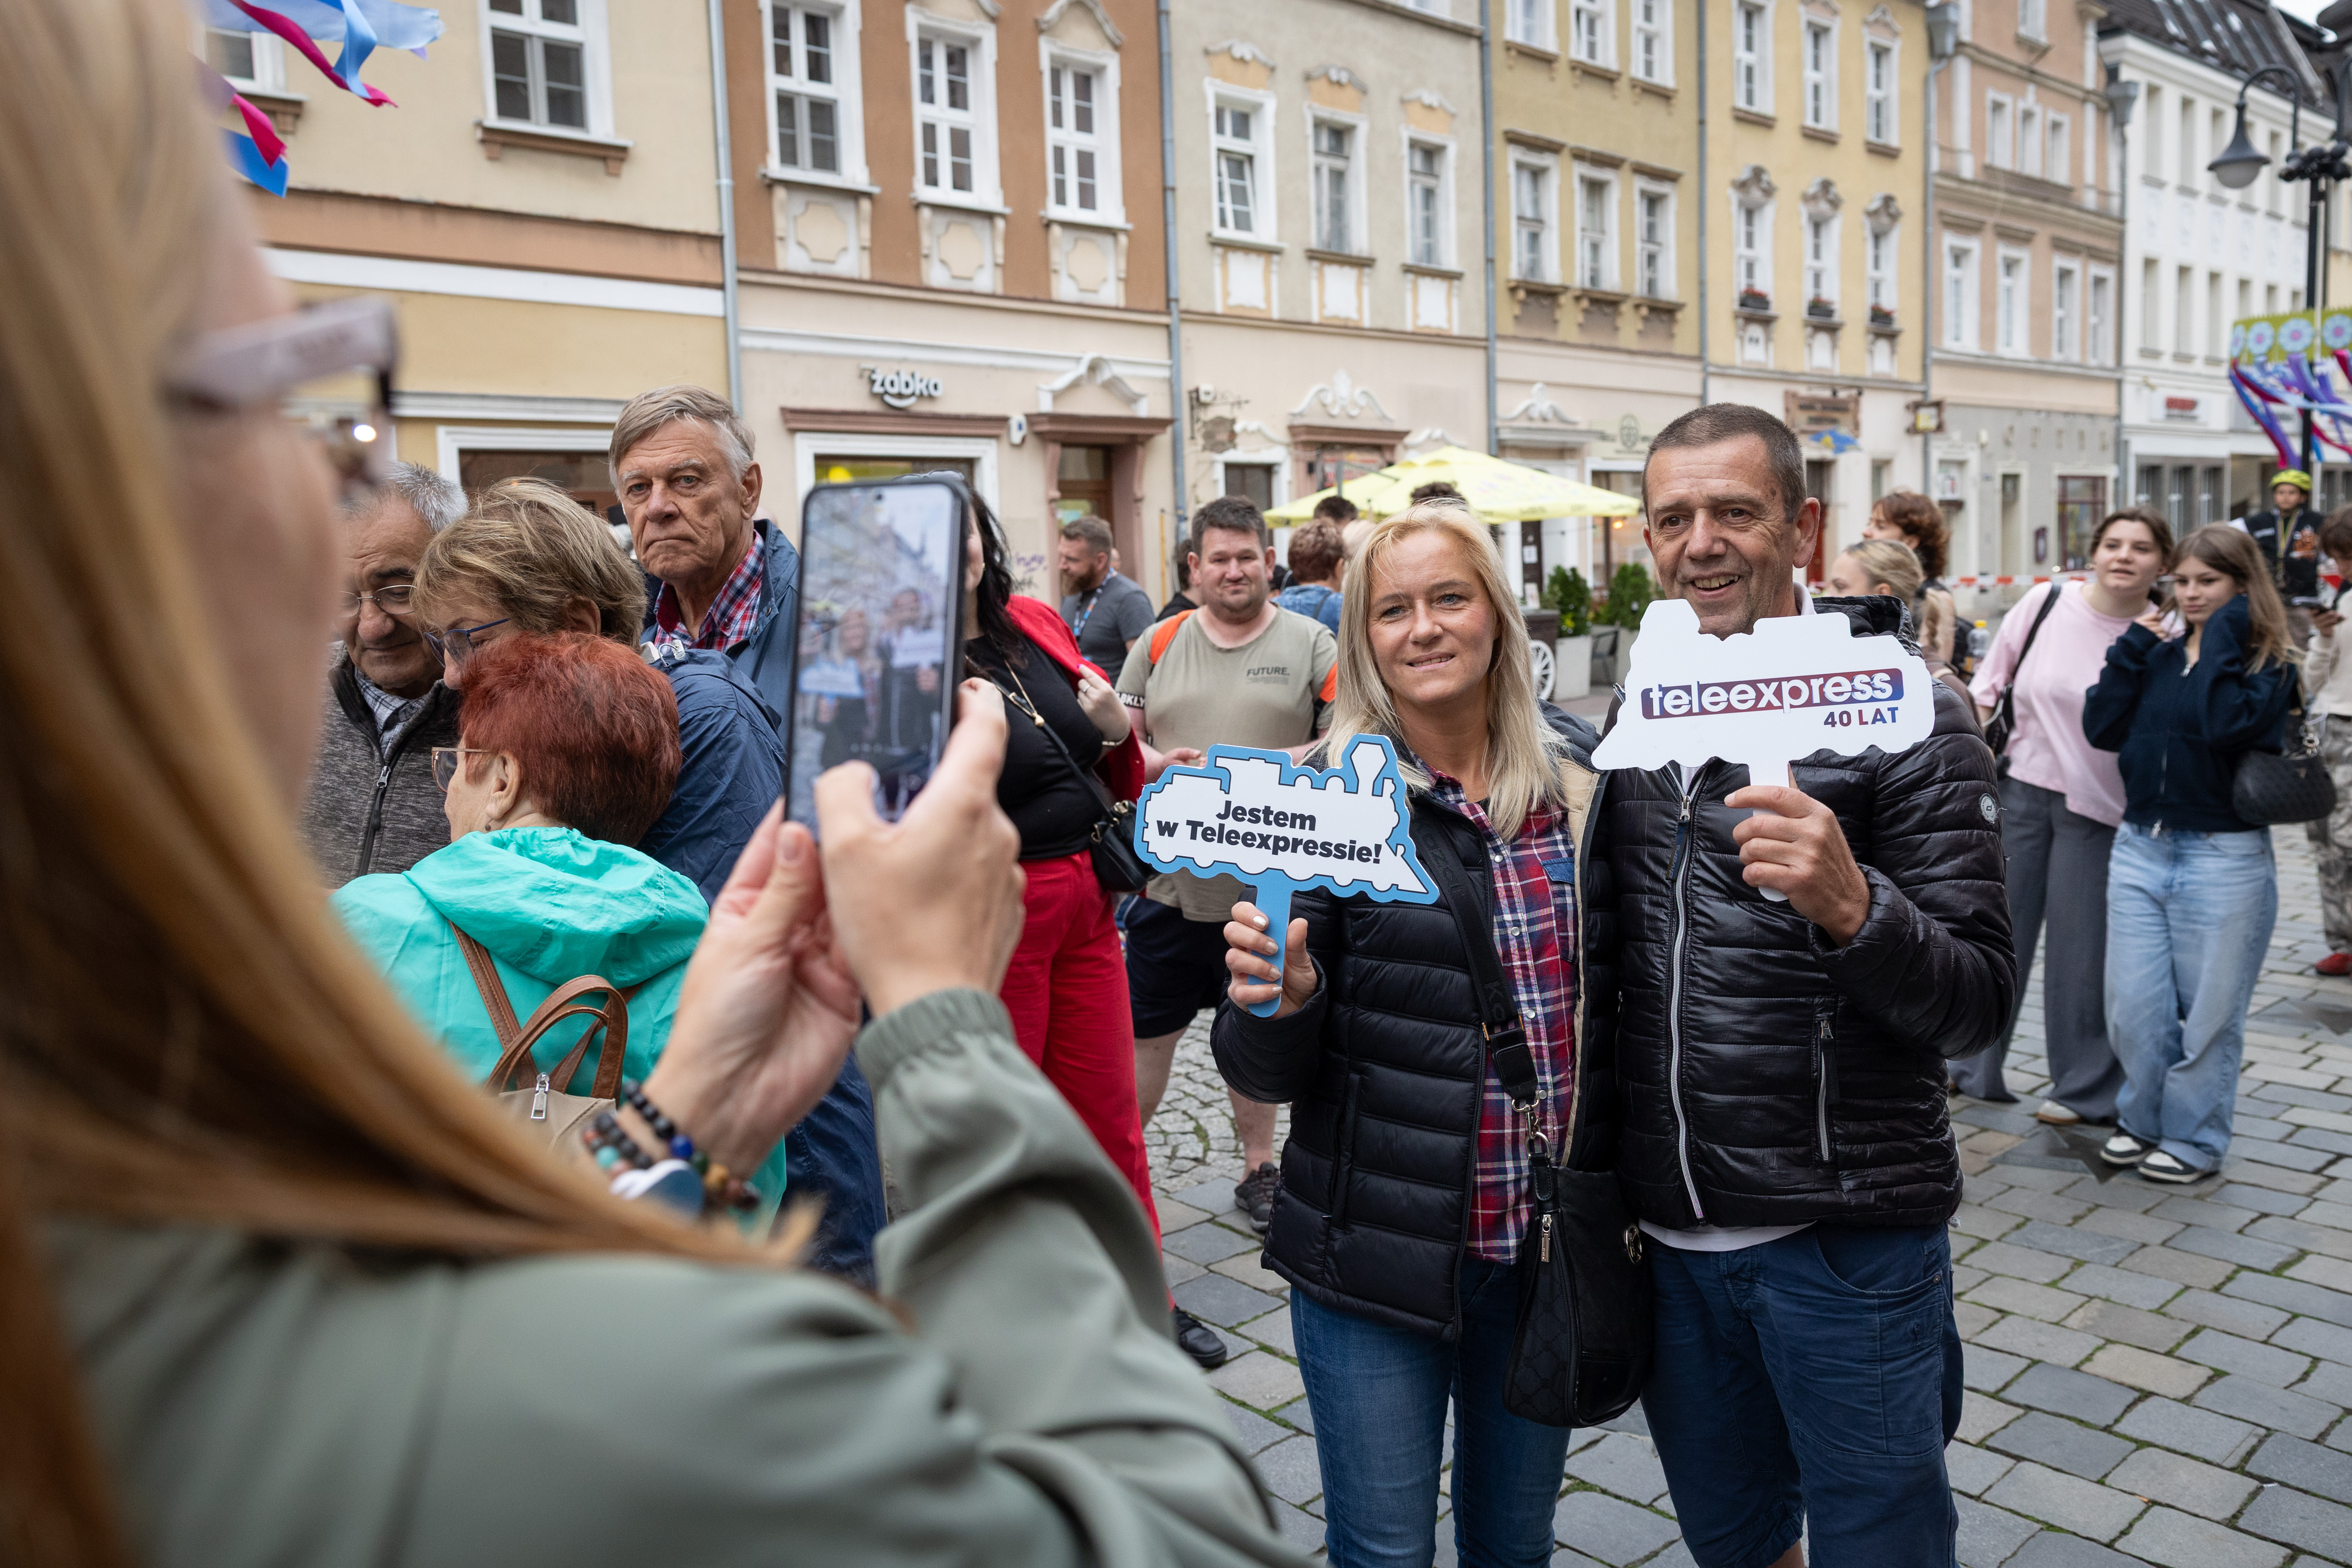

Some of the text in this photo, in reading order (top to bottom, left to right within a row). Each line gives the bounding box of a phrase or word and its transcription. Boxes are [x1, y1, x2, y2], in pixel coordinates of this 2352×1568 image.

[870, 368, 943, 397] żabka
[1247, 666, 1290, 677] FUTURE.
[1649, 672, 1893, 716] teleexpress
[1823, 706, 1899, 728] 40 LAT
[1215, 800, 1317, 831] Jestem
[1156, 819, 1382, 864] w Teleexpressie!
